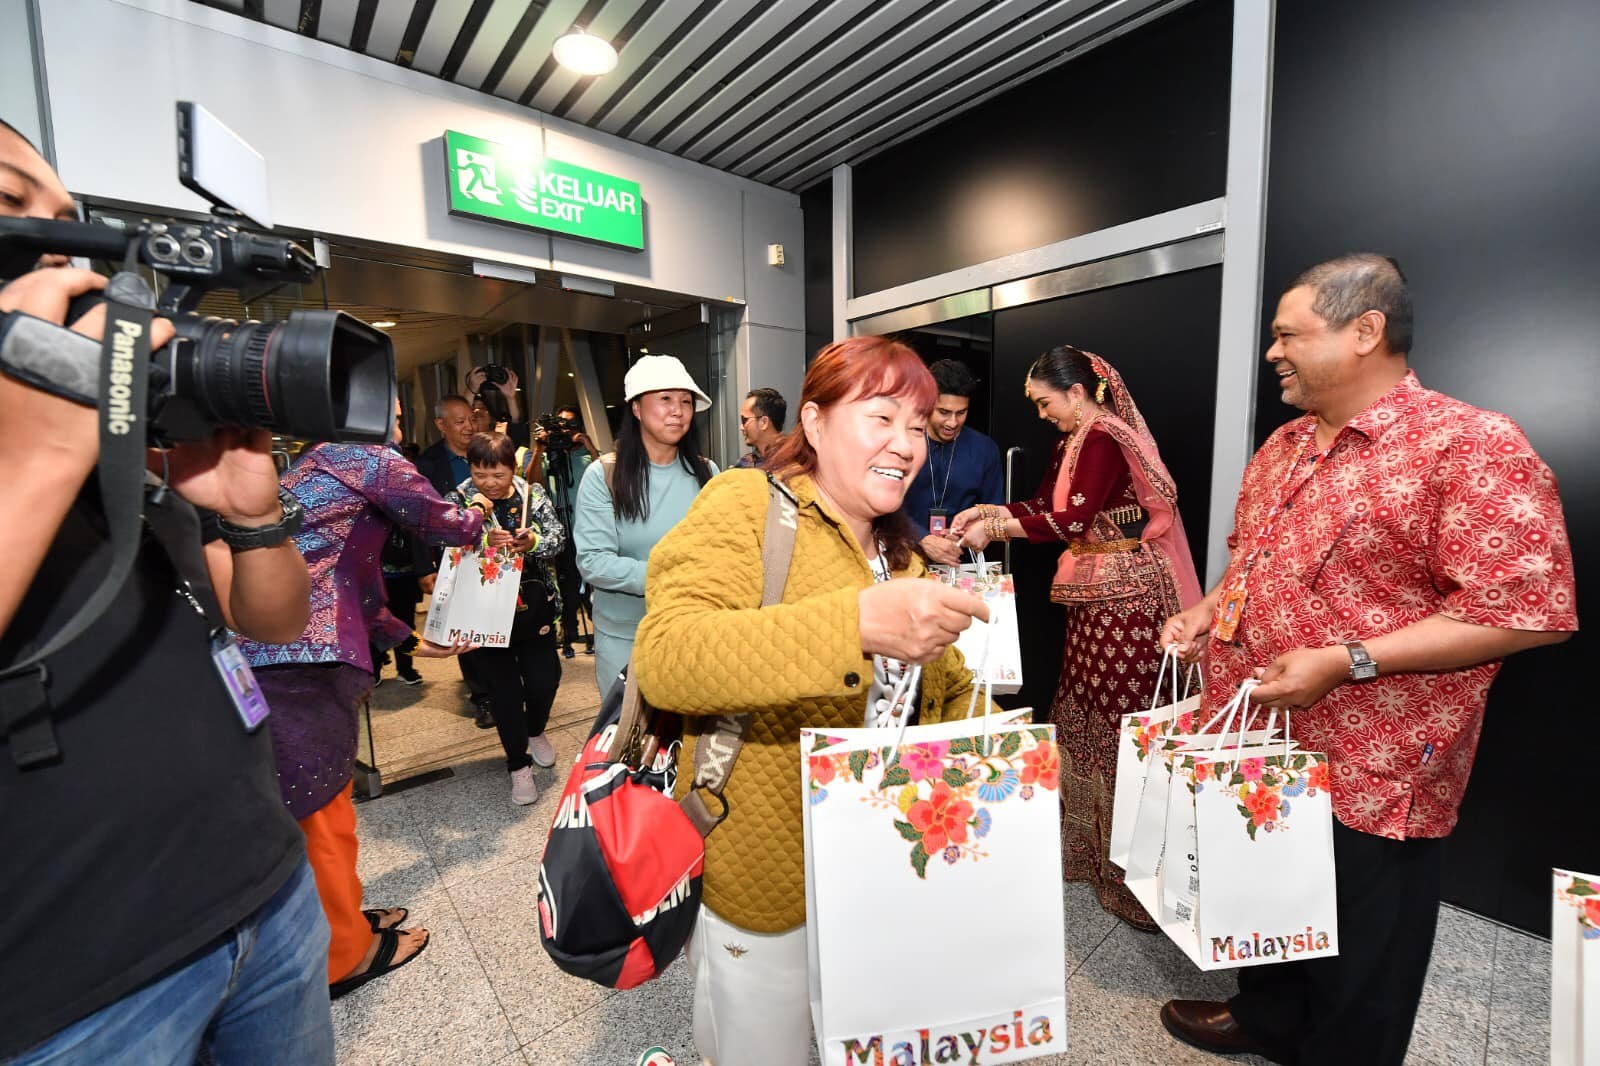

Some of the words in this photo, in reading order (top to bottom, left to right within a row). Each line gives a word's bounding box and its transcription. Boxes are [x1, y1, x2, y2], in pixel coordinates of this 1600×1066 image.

[539, 170, 636, 215] KELUAR
[541, 197, 584, 223] EXIT
[108, 319, 143, 435] Panasonic
[448, 628, 507, 646] Malaysia
[1210, 926, 1331, 961] Malaysia
[840, 1010, 1054, 1066] Malaysia
